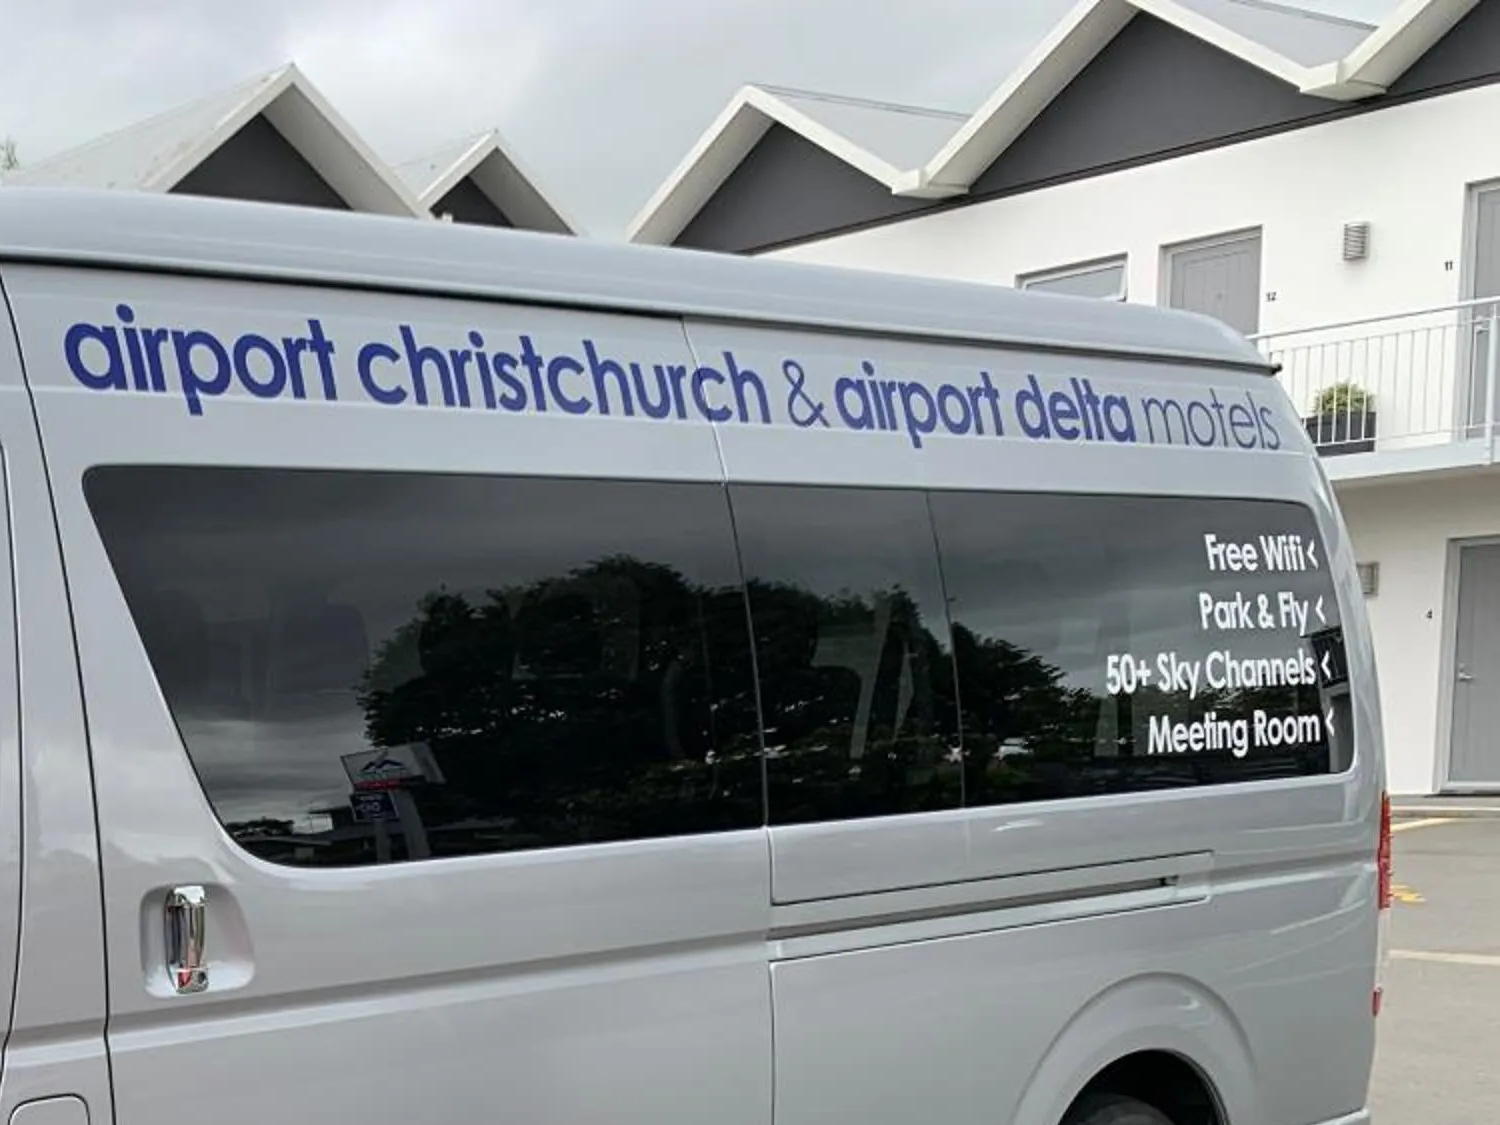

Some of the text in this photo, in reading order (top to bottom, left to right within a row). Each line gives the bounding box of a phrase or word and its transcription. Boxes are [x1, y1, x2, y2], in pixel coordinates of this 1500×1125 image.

[64, 303, 1281, 451] airport christchurch & airport delta motels
[1204, 534, 1307, 571] Free Wifi
[1200, 592, 1308, 636] Park & Fly
[1106, 650, 1317, 700] 50+ Sky Channels
[1148, 710, 1321, 759] Meeting Room
